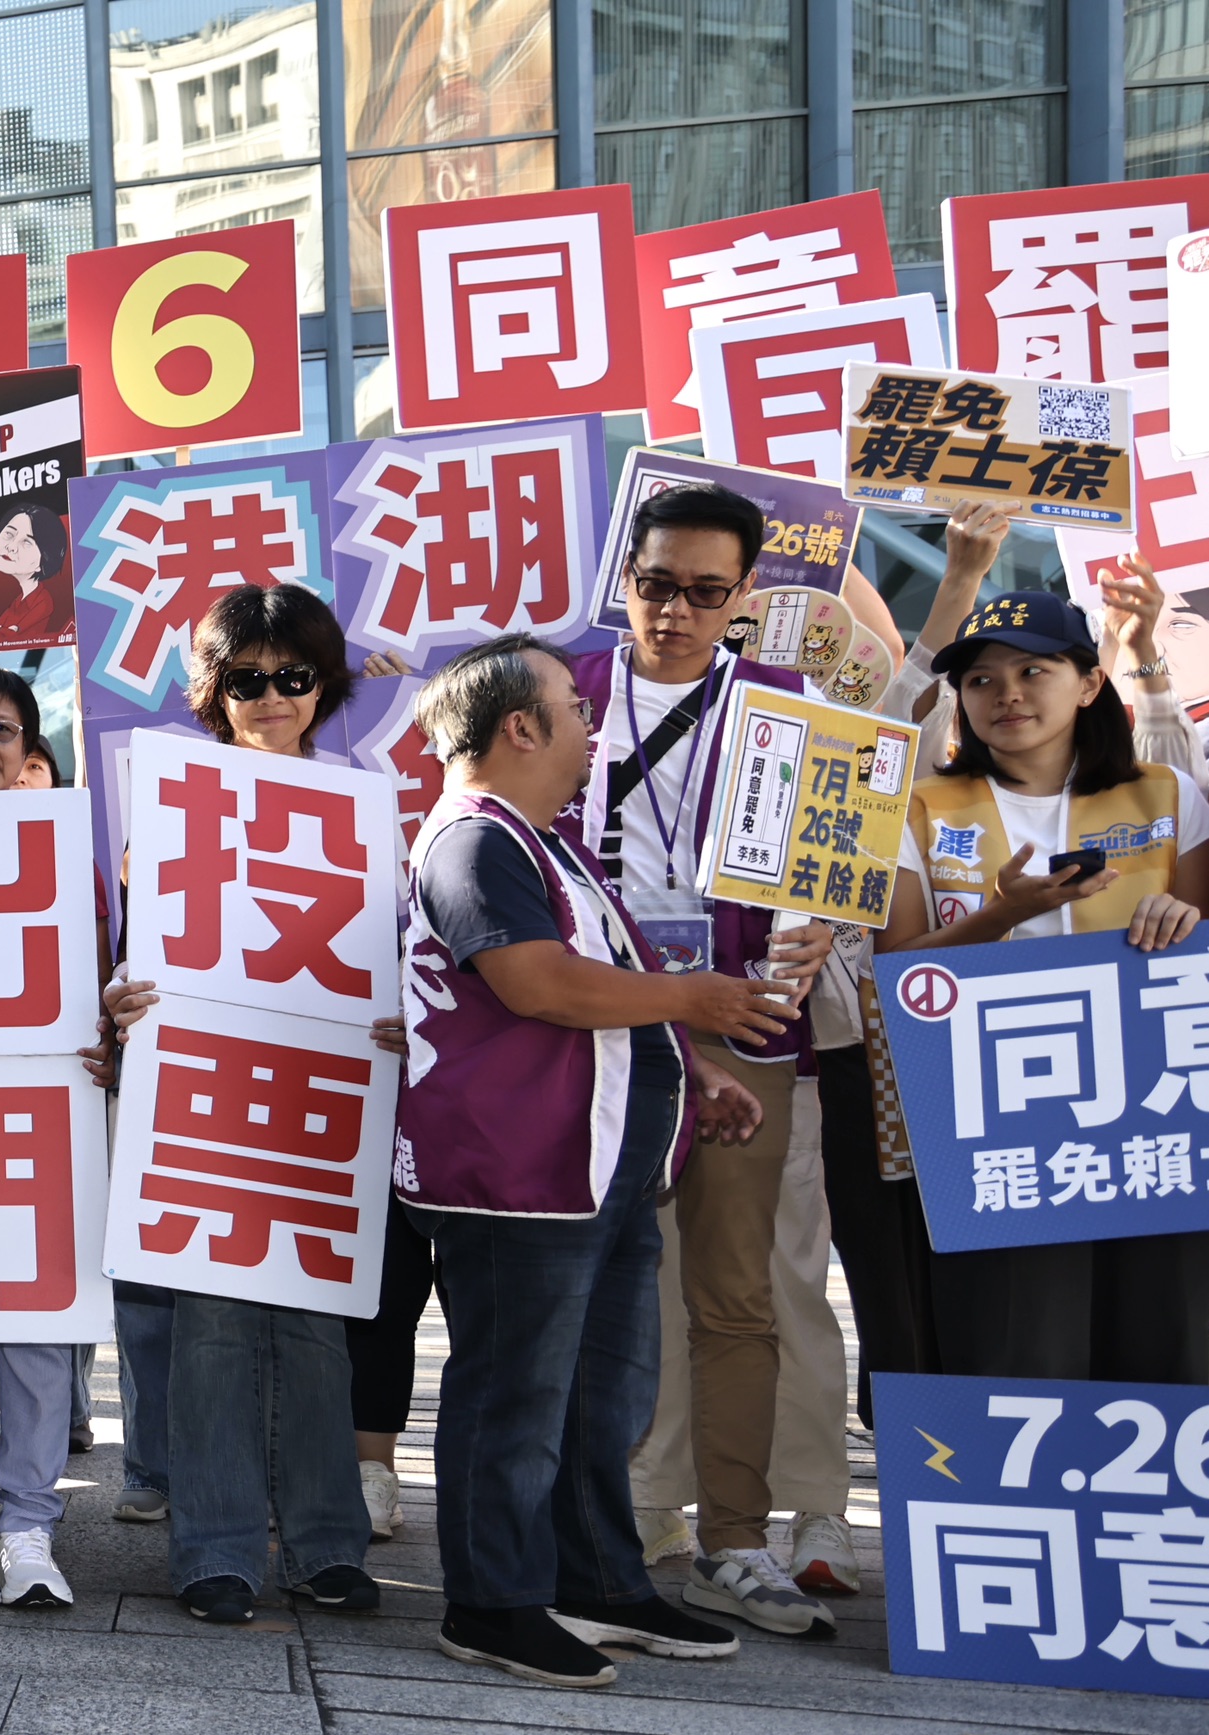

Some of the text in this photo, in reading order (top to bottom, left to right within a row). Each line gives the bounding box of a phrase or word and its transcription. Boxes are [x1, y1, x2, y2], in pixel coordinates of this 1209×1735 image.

[417, 212, 609, 400] 同
[985, 202, 1188, 382] 罷
[111, 250, 254, 428] 6
[860, 375, 1006, 431] 罷免
[851, 424, 1125, 501] 賴士葆
[761, 516, 844, 567] 26號
[823, 509, 844, 522] 週六
[740, 756, 766, 834] 同意罷免
[811, 756, 851, 805] 7月
[875, 758, 888, 775] 26
[737, 844, 770, 867] 李彥秀
[799, 805, 863, 857] 26號
[972, 1132, 1209, 1213] 罷免賴
[907, 1500, 1209, 1671] 同意
